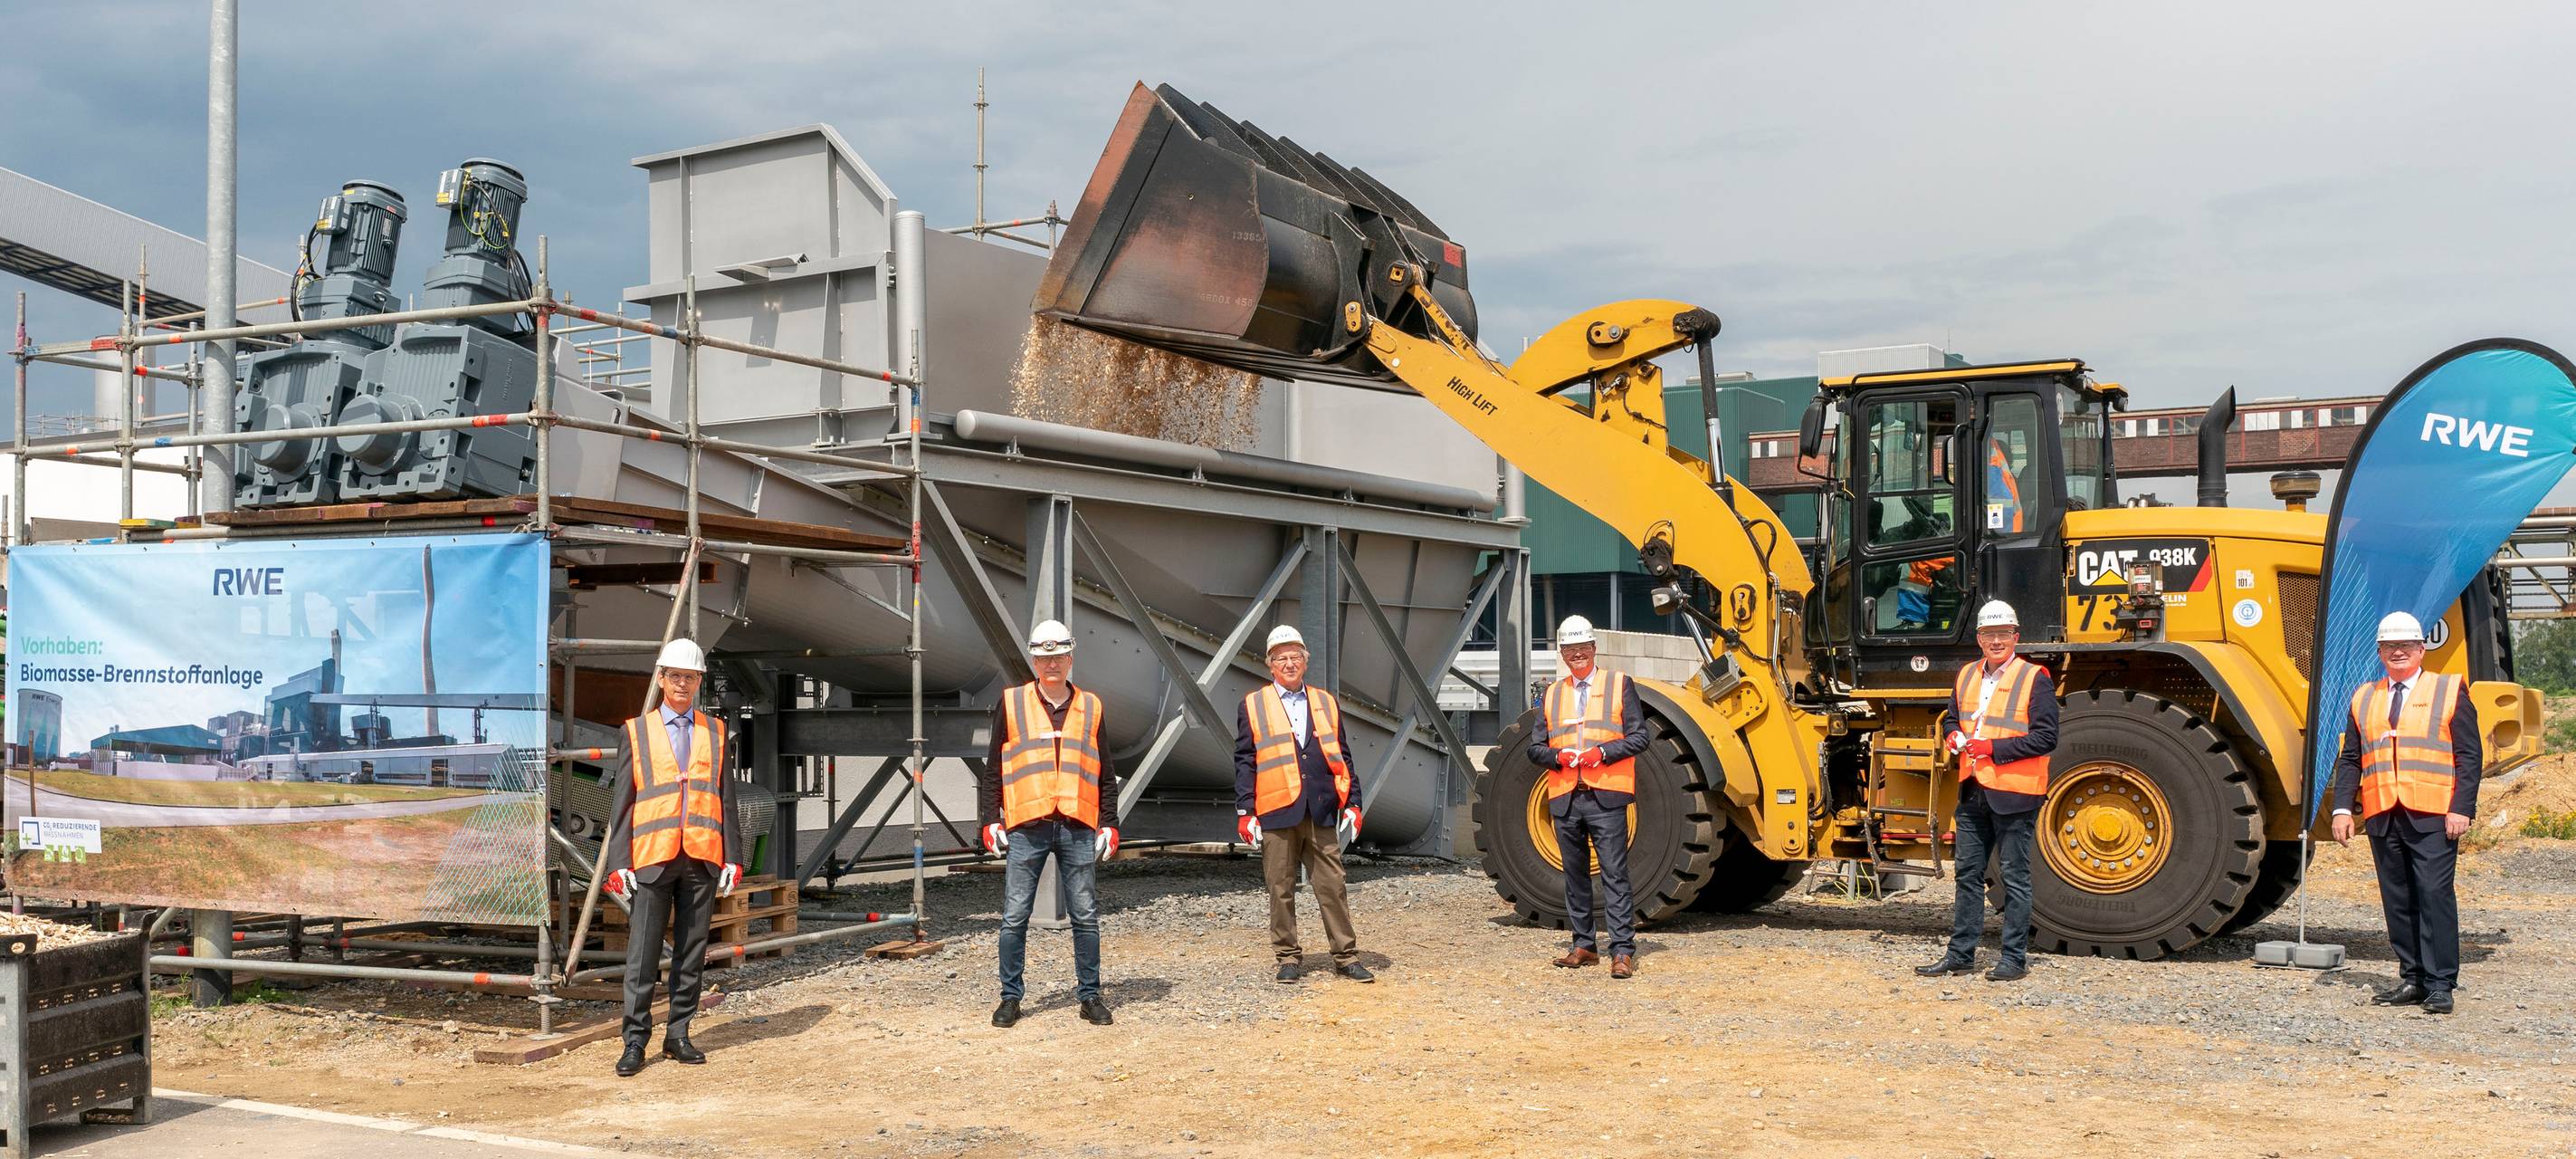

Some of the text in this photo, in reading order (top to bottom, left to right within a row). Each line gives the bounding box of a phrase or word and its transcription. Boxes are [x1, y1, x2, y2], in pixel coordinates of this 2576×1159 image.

[1446, 376, 1498, 416] HIGH LIFT
[2420, 412, 2534, 457] RWE
[2078, 550, 2138, 586] CAT
[2149, 547, 2197, 567] 938K
[213, 567, 284, 596] RWE
[2237, 578, 2247, 587] 101
[2161, 594, 2187, 603] ELIN
[21, 636, 103, 655] Vorhaben:
[20, 663, 263, 689] Biomasse-Brennstoffanlage
[52, 822, 98, 831] REDUZIERENDE
